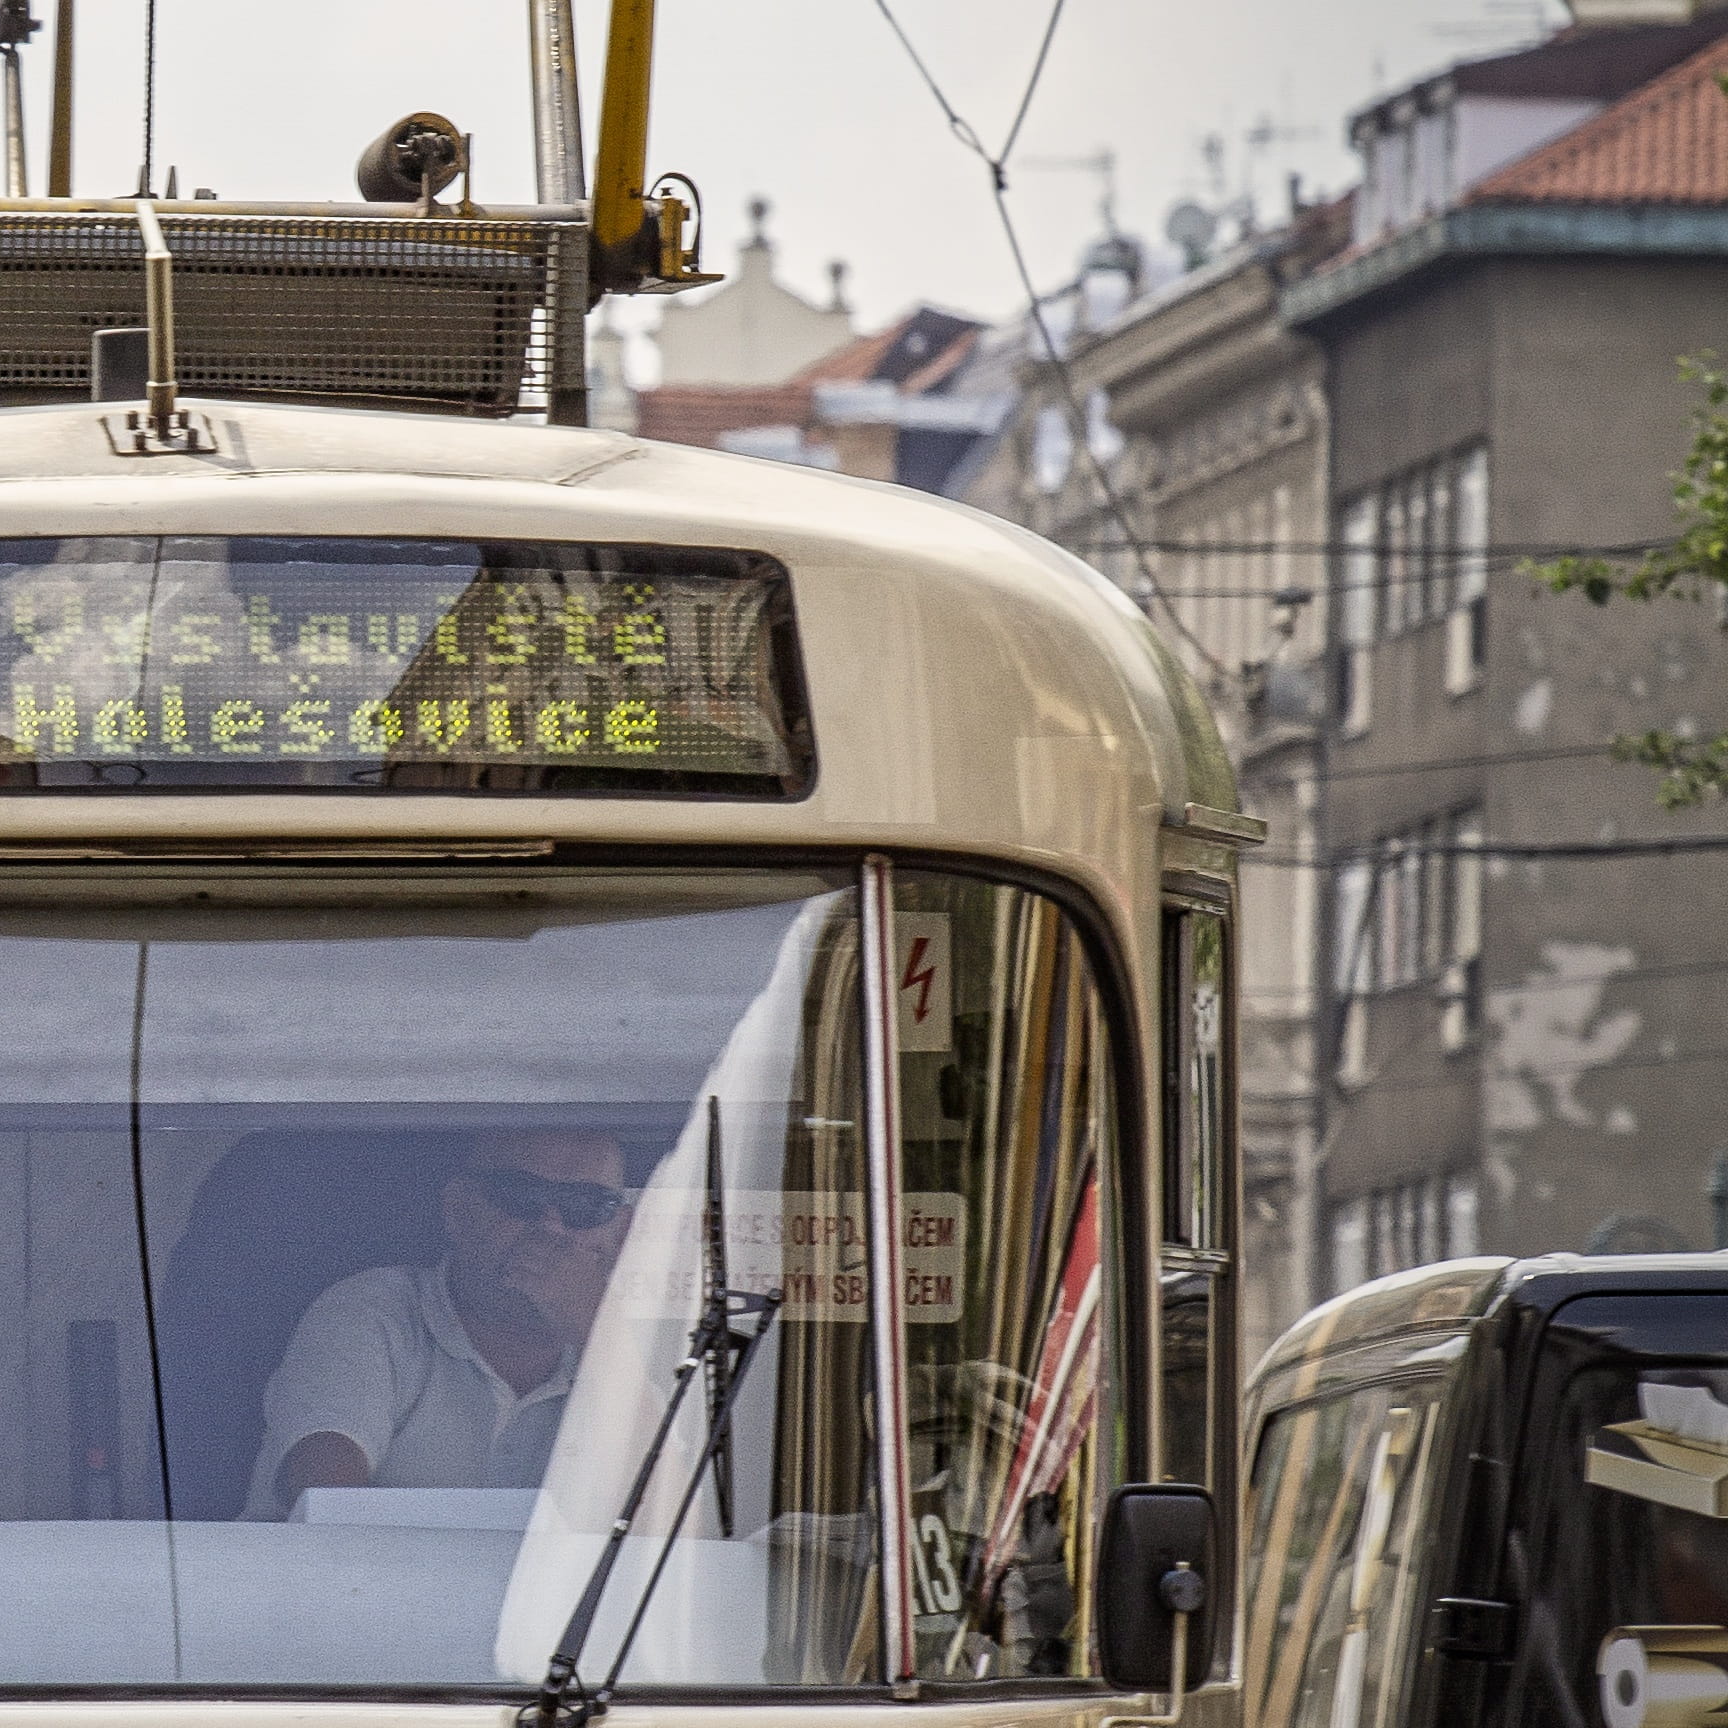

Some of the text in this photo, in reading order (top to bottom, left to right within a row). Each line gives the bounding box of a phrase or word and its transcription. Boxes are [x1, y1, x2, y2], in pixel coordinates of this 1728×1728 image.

[14, 673, 663, 755] Holešovice
[833, 1267, 955, 1306] SBČEM
[910, 1514, 962, 1616] 13
